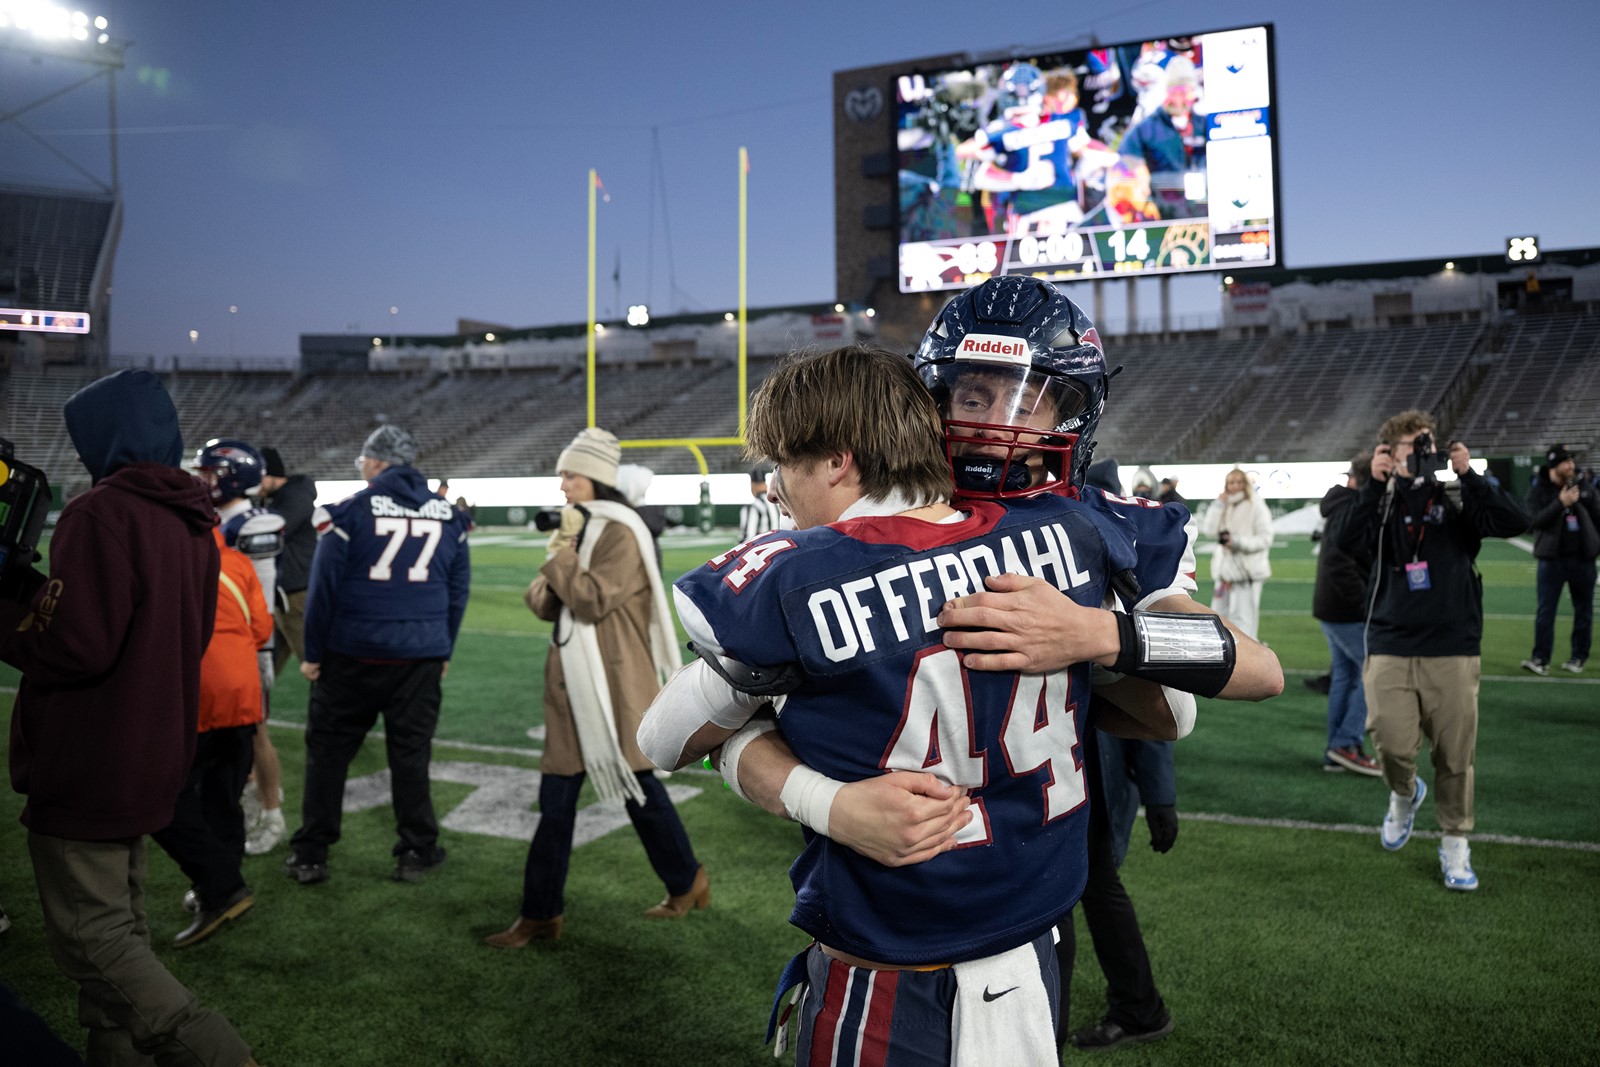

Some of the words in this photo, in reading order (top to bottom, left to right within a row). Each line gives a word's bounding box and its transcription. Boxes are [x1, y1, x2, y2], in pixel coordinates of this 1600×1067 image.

[1019, 232, 1083, 265] 0:00
[1108, 228, 1150, 261] 14
[963, 339, 1024, 356] Riddell
[965, 465, 993, 474] Riddell
[368, 517, 443, 582] 77
[807, 523, 1091, 663] OFFERDAHL
[879, 644, 1087, 848] 44
